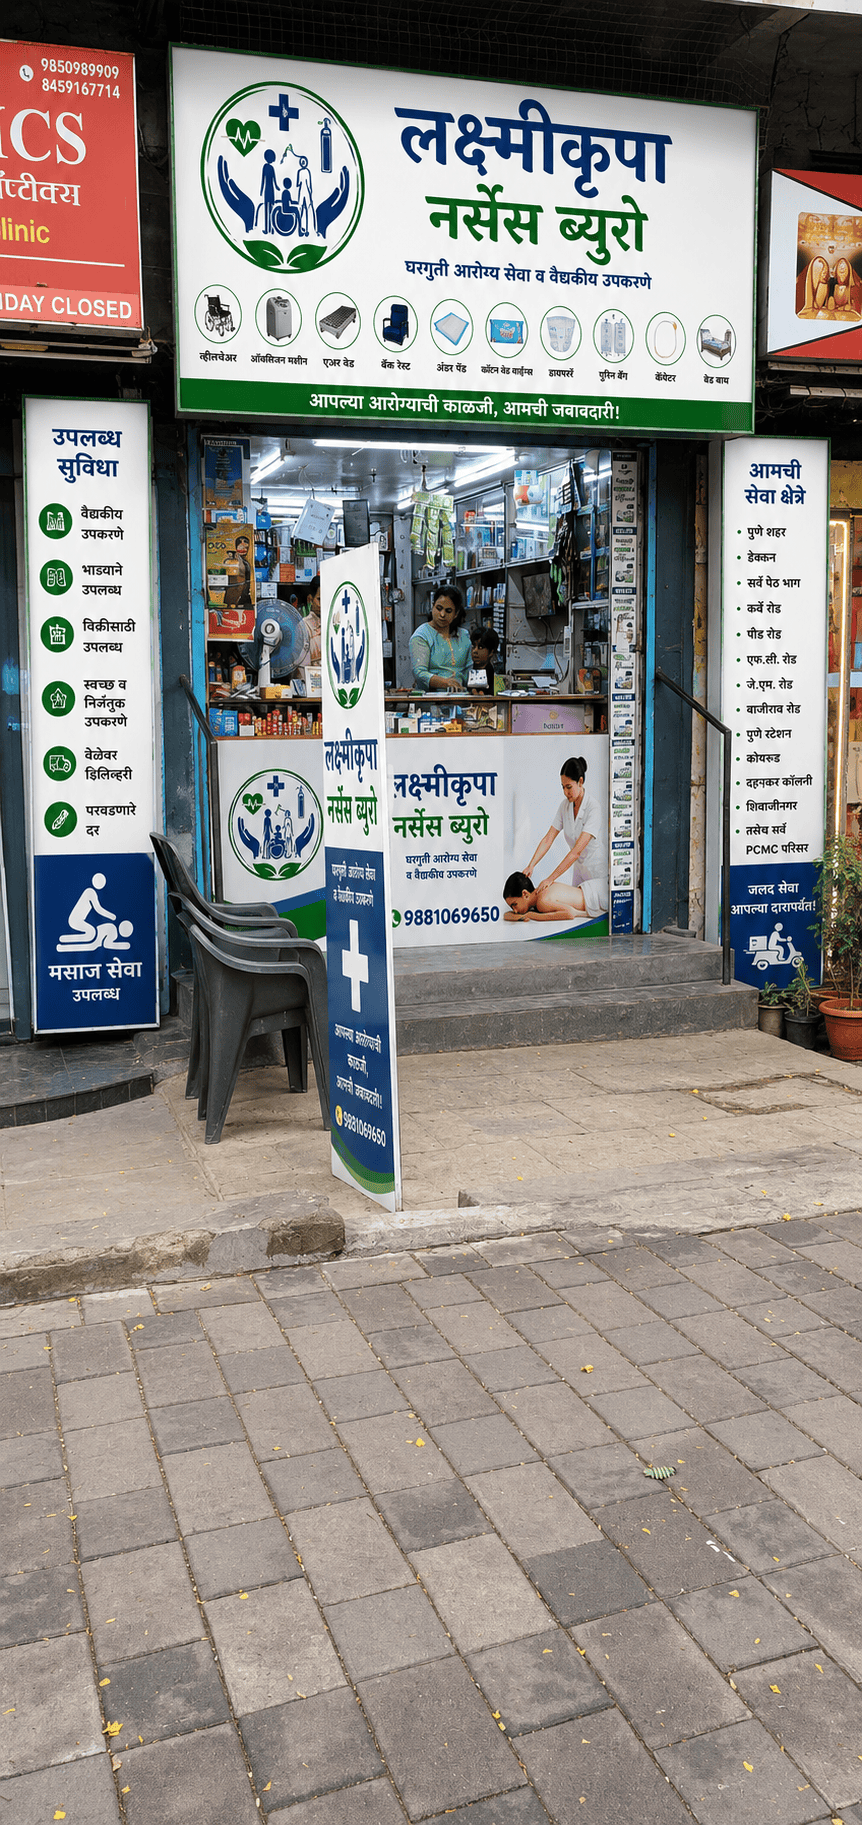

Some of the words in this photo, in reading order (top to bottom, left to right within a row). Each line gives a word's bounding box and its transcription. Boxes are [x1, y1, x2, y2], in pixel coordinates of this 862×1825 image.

[40, 57, 120, 81] 9850989909
[41, 76, 121, 99] 8459167714
[393, 97, 674, 200] लक्ष्मीकृपा
[0, 216, 51, 244] linic
[424, 183, 544, 246] नर्सेस
[553, 193, 649, 268] ब्युरो
[404, 257, 450, 282] घरगुती
[503, 262, 532, 283] सेवा
[534, 269, 546, 284] व
[548, 265, 599, 287] वैद्यकीय
[601, 271, 653, 290] उपकरणे
[0, 292, 45, 313] DAY
[51, 296, 132, 319] CLOSED
[309, 393, 365, 410] आपल्या
[502, 397, 549, 417] आमची
[56, 452, 120, 484] सुविधा
[749, 458, 803, 480] आमची
[743, 483, 777, 505] सेवा
[80, 504, 124, 520] वैद्यकीय
[80, 525, 125, 541] उपकरणे
[746, 524, 765, 541] पुणे
[766, 527, 787, 539] शहर
[782, 578, 801, 588] भाग
[765, 600, 782, 614] रोड
[82, 617, 137, 633] विक्रीसाठी
[765, 626, 782, 640] रोड
[781, 651, 798, 665] रोड
[83, 679, 116, 691] स्वच्छ
[117, 679, 128, 691] व
[778, 676, 794, 690] रोड
[785, 701, 802, 714] रोड
[84, 712, 128, 727] उपकरणे
[745, 726, 763, 743] पुणे
[84, 746, 119, 761] वेळेवर
[323, 727, 379, 784] लक्ष्मीकृपा
[781, 773, 813, 787] कॉलनी
[85, 802, 137, 817] परवडणारे
[745, 798, 798, 812] शिवाजीनगर
[85, 825, 101, 837] दर
[391, 807, 444, 839] नर्सेस
[447, 805, 490, 845] ब्युरो
[461, 850, 478, 863] सेवा
[746, 844, 779, 856] PCMC
[780, 841, 810, 854] परिसर
[747, 884, 775, 896] जलद
[777, 879, 800, 894] सेवा
[403, 905, 500, 927] 9881069650
[730, 903, 769, 915] आपल्या
[47, 963, 103, 981] मसाज
[105, 956, 143, 979] सेवा
